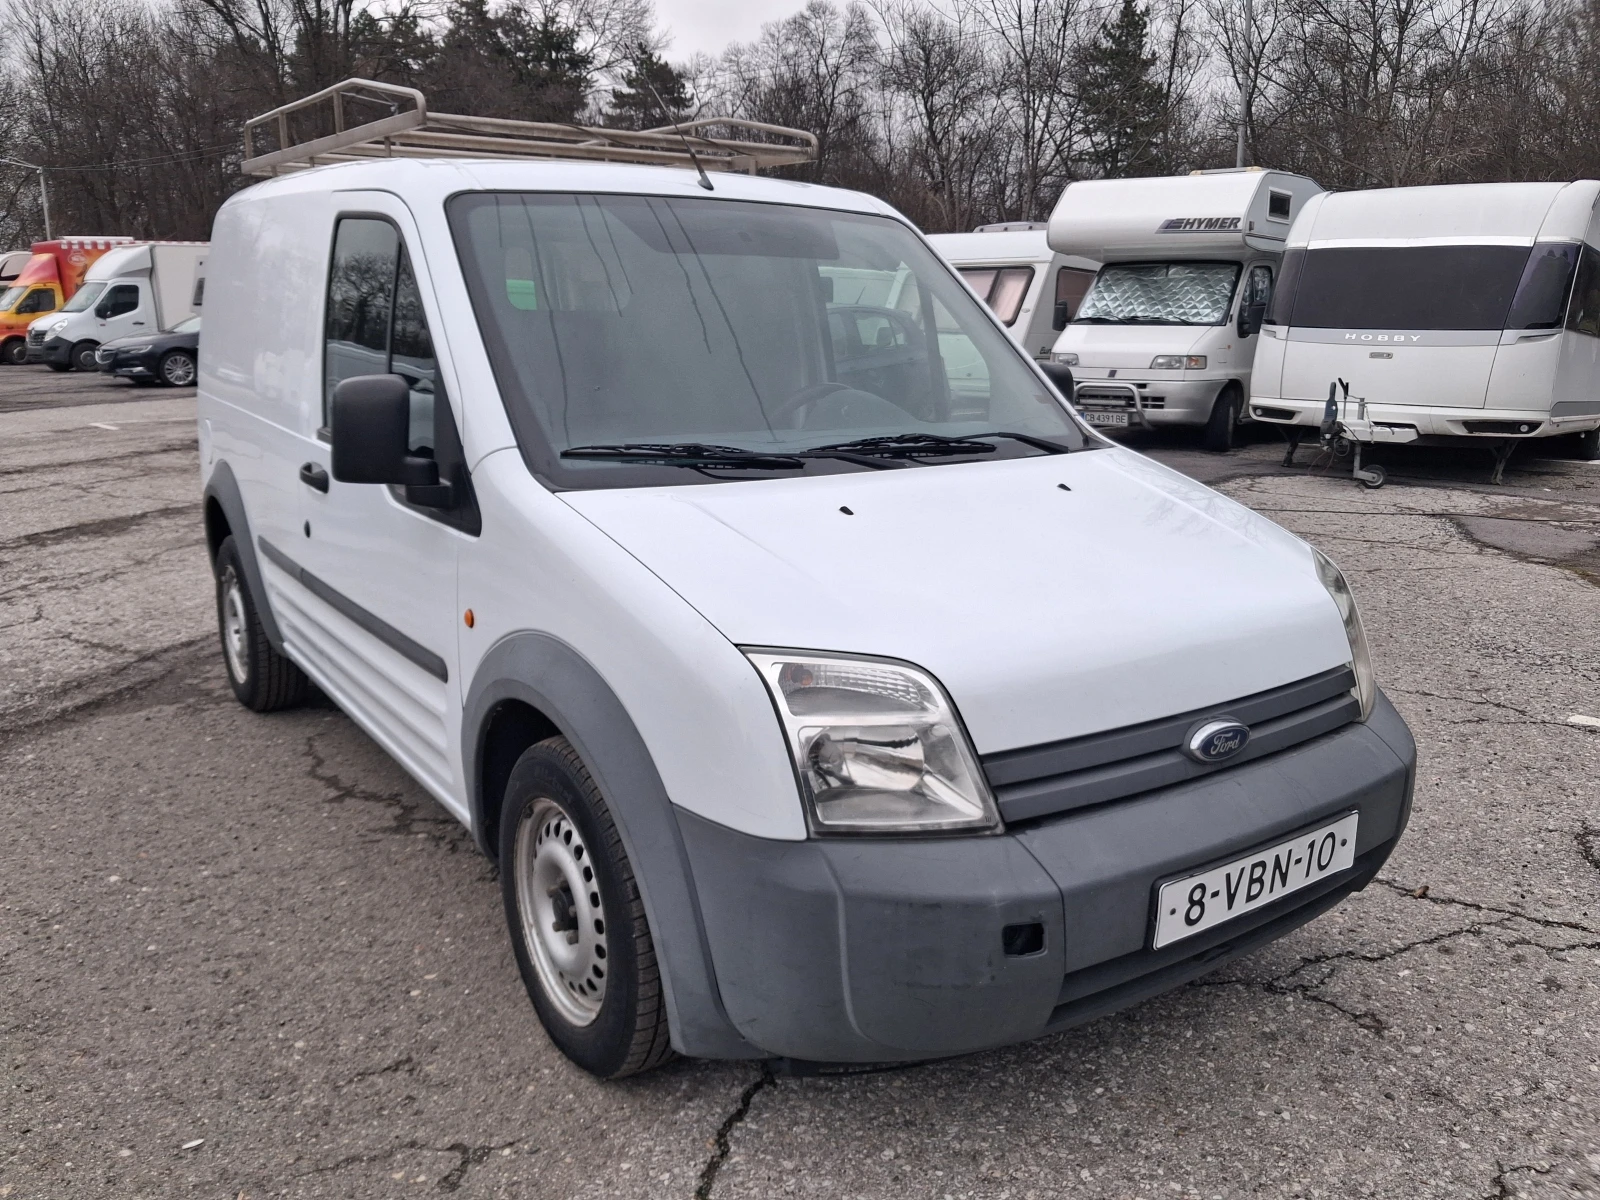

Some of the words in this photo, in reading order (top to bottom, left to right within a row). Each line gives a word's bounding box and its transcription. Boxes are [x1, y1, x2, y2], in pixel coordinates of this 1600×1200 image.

[1181, 216, 1242, 230] HYMER
[1344, 333, 1421, 342] HOBBY
[1085, 413, 1095, 422] CB
[1096, 414, 1114, 423] 4391
[1115, 415, 1127, 424] BE
[1210, 732, 1240, 755] Ford
[1184, 831, 1336, 927] 8-VBN-10
